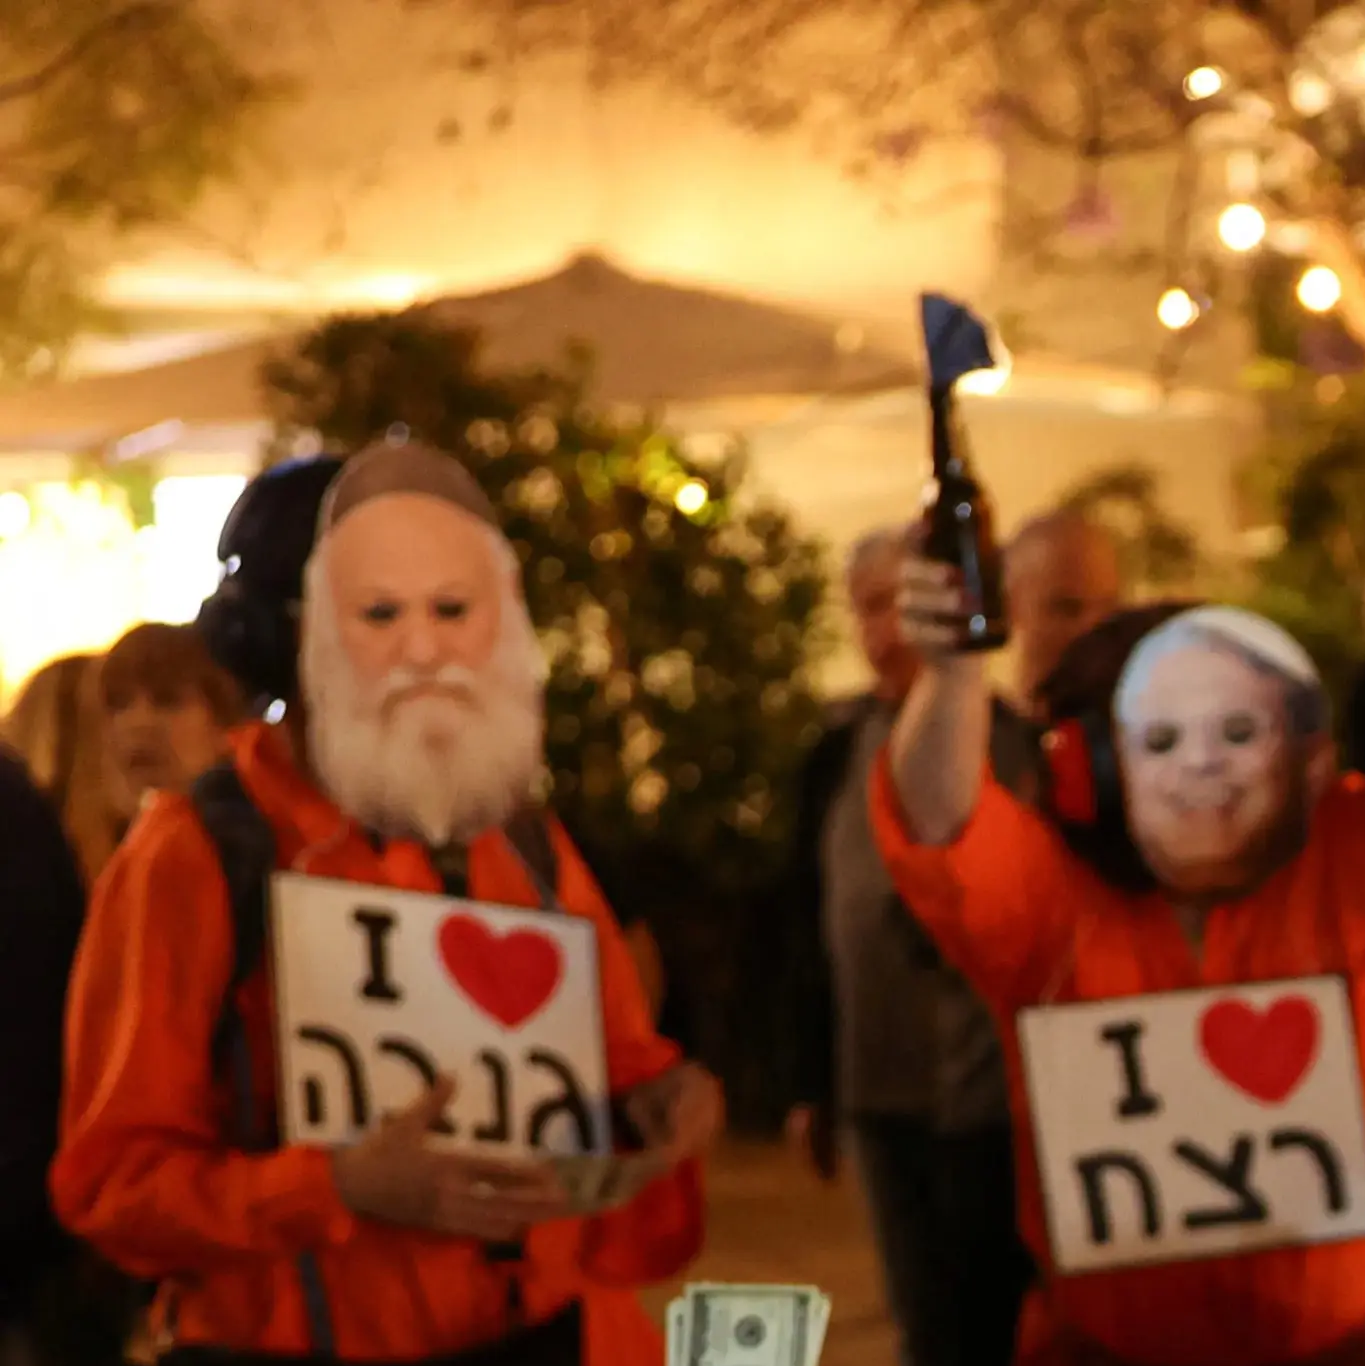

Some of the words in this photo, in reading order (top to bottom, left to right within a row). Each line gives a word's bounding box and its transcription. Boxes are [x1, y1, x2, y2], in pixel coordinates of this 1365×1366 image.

[353, 907, 403, 1004] I
[1100, 1022, 1161, 1119] I
[1076, 1127, 1349, 1245] רצח
